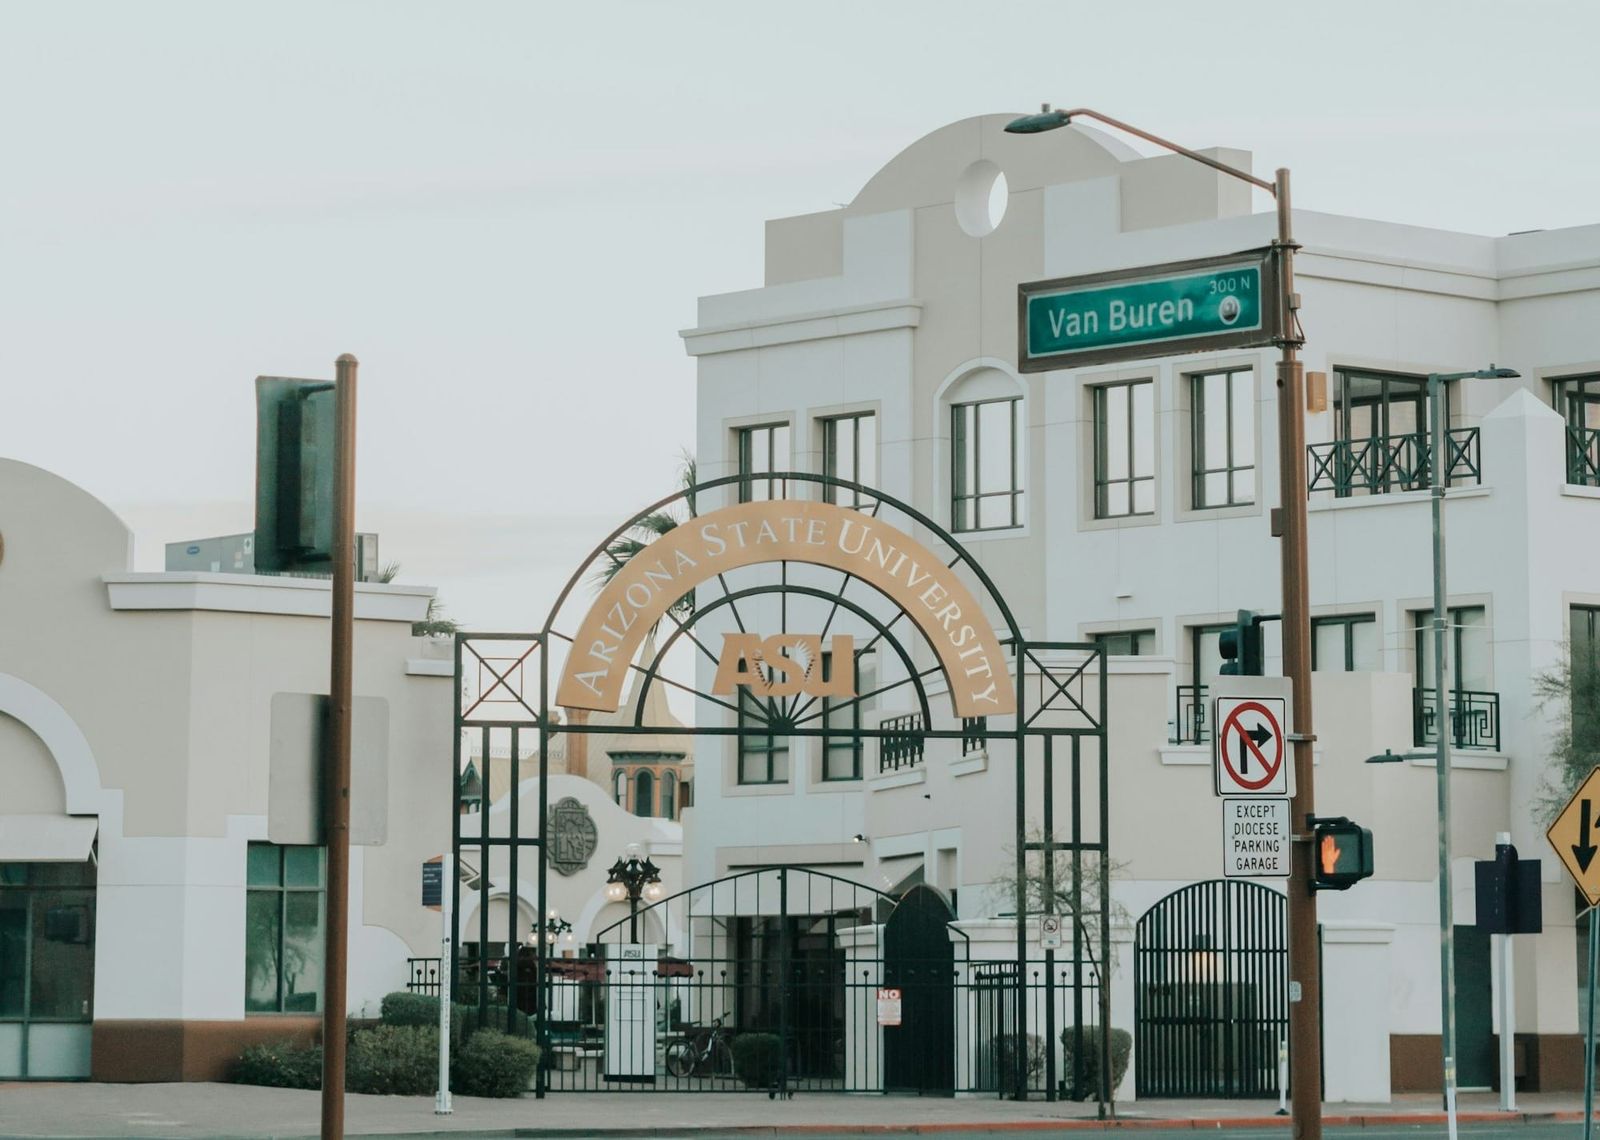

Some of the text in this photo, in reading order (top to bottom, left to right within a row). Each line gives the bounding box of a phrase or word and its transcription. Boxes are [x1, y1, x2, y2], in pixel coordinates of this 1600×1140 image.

[1209, 275, 1250, 295] 300 N
[1049, 298, 1193, 338] Van Buren
[574, 517, 998, 705] ARIZONA STATE UNIVERSITY
[712, 632, 858, 698] ASU
[1237, 805, 1276, 818] EXCEPT
[1234, 822, 1279, 835] DIOCESE
[1234, 840, 1279, 853] PARKING
[1236, 857, 1278, 870] GARAGE
[879, 989, 900, 999] NO
